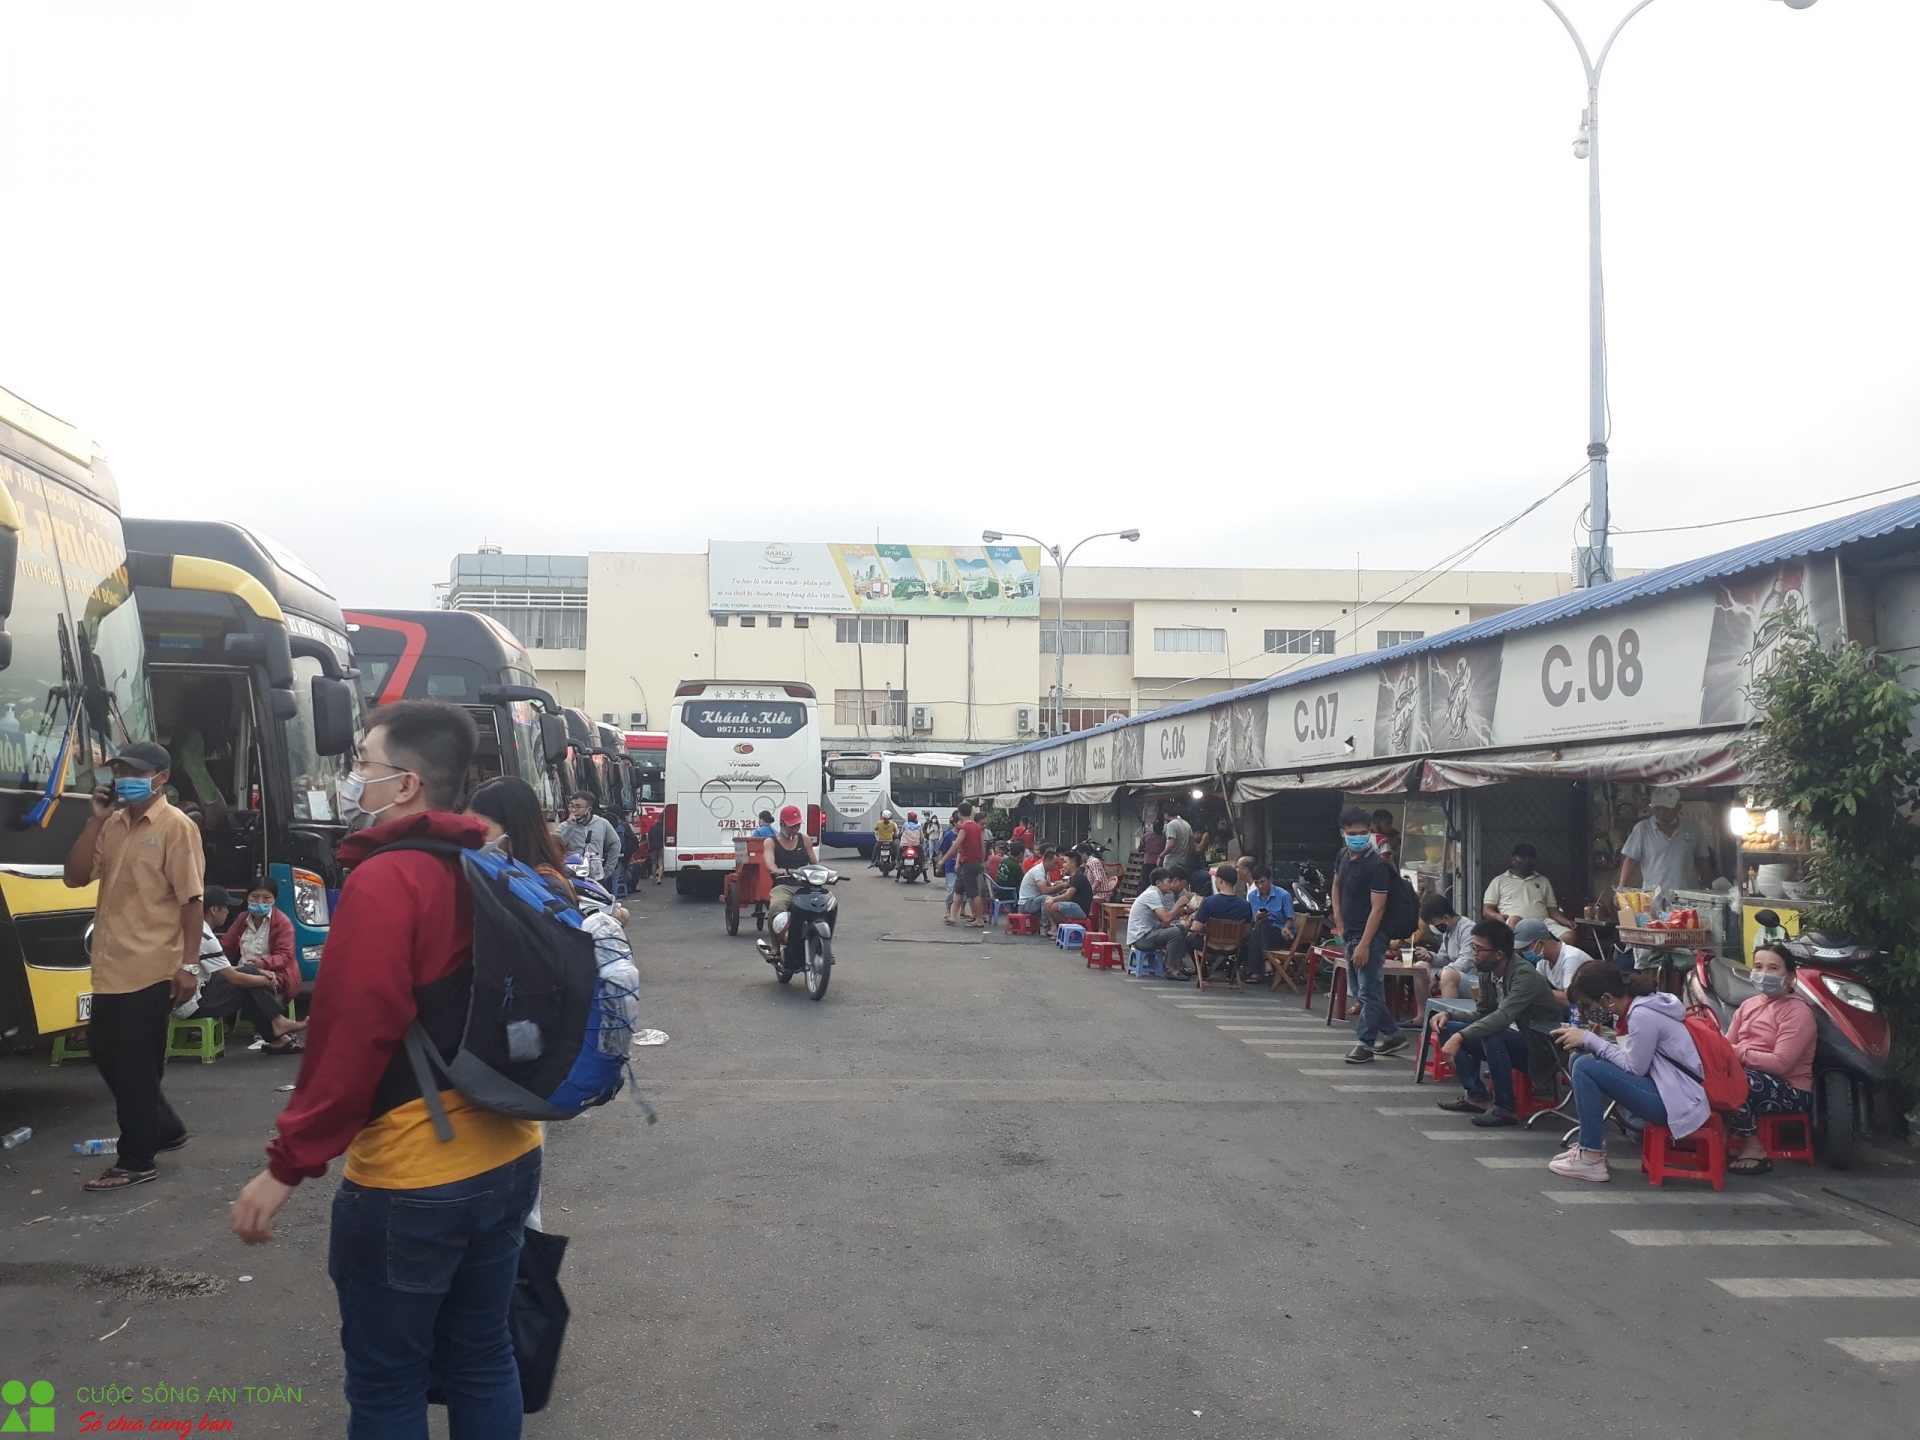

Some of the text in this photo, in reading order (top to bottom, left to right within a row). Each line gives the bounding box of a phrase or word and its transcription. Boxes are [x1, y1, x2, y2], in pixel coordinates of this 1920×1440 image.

[34, 508, 130, 586] PHƯƠNG
[18, 559, 38, 578] TUY
[1541, 628, 1643, 707] C.08
[700, 711, 749, 724] Khánh
[1294, 692, 1339, 742] C.07
[1160, 725, 1186, 761] C.06
[1046, 756, 1059, 778] C.04
[1092, 747, 1106, 771] C.05
